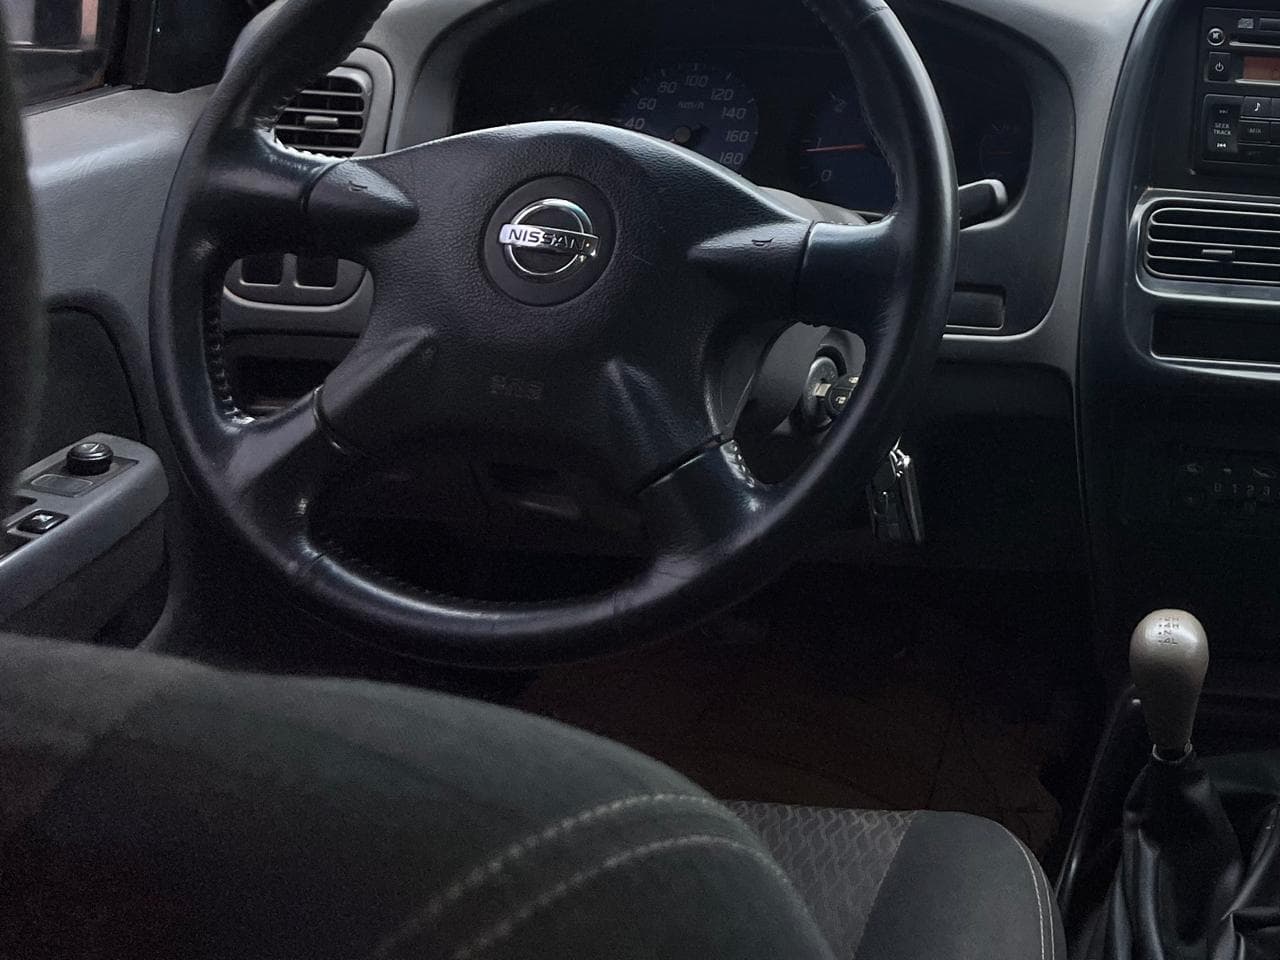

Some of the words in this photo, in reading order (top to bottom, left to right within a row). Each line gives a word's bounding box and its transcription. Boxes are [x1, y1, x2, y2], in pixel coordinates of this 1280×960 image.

[656, 81, 678, 94] 80
[684, 74, 709, 88] 100
[710, 87, 735, 101] 120
[636, 97, 658, 111] 60
[721, 106, 747, 120] 140
[623, 117, 646, 131] 40
[724, 129, 750, 143] 160
[719, 151, 745, 166] 180
[508, 228, 585, 250] NISSAN
